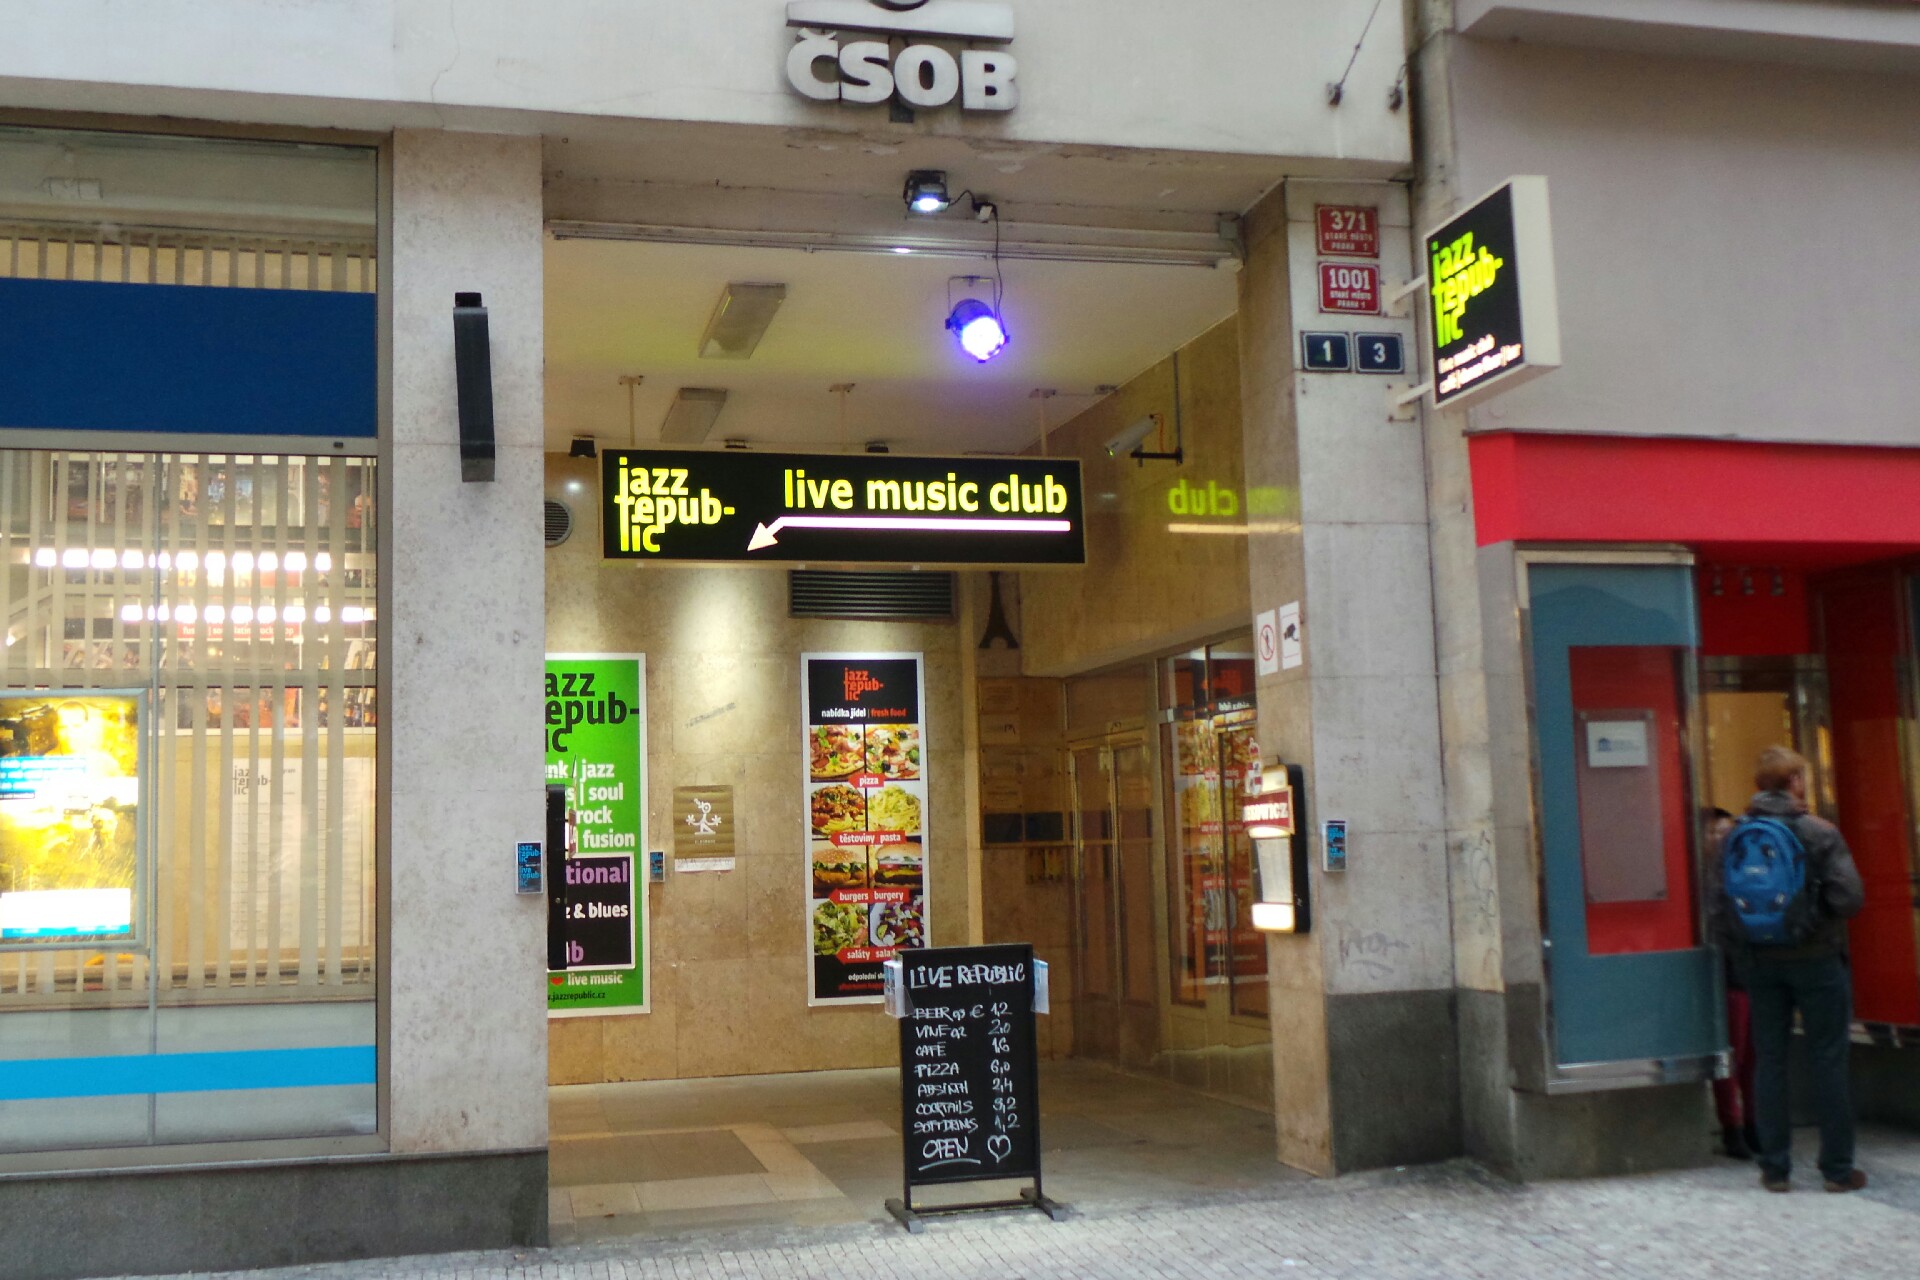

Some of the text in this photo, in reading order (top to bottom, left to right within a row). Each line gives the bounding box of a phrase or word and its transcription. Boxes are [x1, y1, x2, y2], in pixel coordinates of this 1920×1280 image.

[785, 27, 1020, 111] ČSOB
[1330, 210, 1367, 231] 371
[1432, 232, 1476, 280] jazz
[1329, 268, 1370, 290] 1001
[1436, 309, 1464, 348] lic
[1322, 340, 1332, 363] 1
[1373, 342, 1386, 364] 3
[618, 456, 689, 496] jazz
[784, 468, 1068, 514] live music club
[614, 488, 735, 533] repub-
[619, 523, 662, 552] lic
[545, 672, 596, 697] azz
[844, 667, 869, 680] jazz
[545, 691, 639, 734] epub-
[579, 758, 615, 782] jazz
[859, 775, 879, 786] pizza
[588, 782, 624, 801] soul
[576, 805, 613, 824] rock
[583, 828, 636, 849] fusion
[839, 832, 901, 844] těstoviny pasta
[565, 860, 628, 885] tional
[839, 890, 904, 902] burgers burgery
[573, 903, 586, 918] &
[588, 902, 629, 917] blues
[847, 949, 870, 960] saláty
[567, 971, 623, 986] live music
[970, 1004, 985, 1018] €
[990, 1059, 1010, 1074] 6,0
[992, 1077, 1013, 1093] 2,4
[922, 1135, 969, 1159] OPEN
